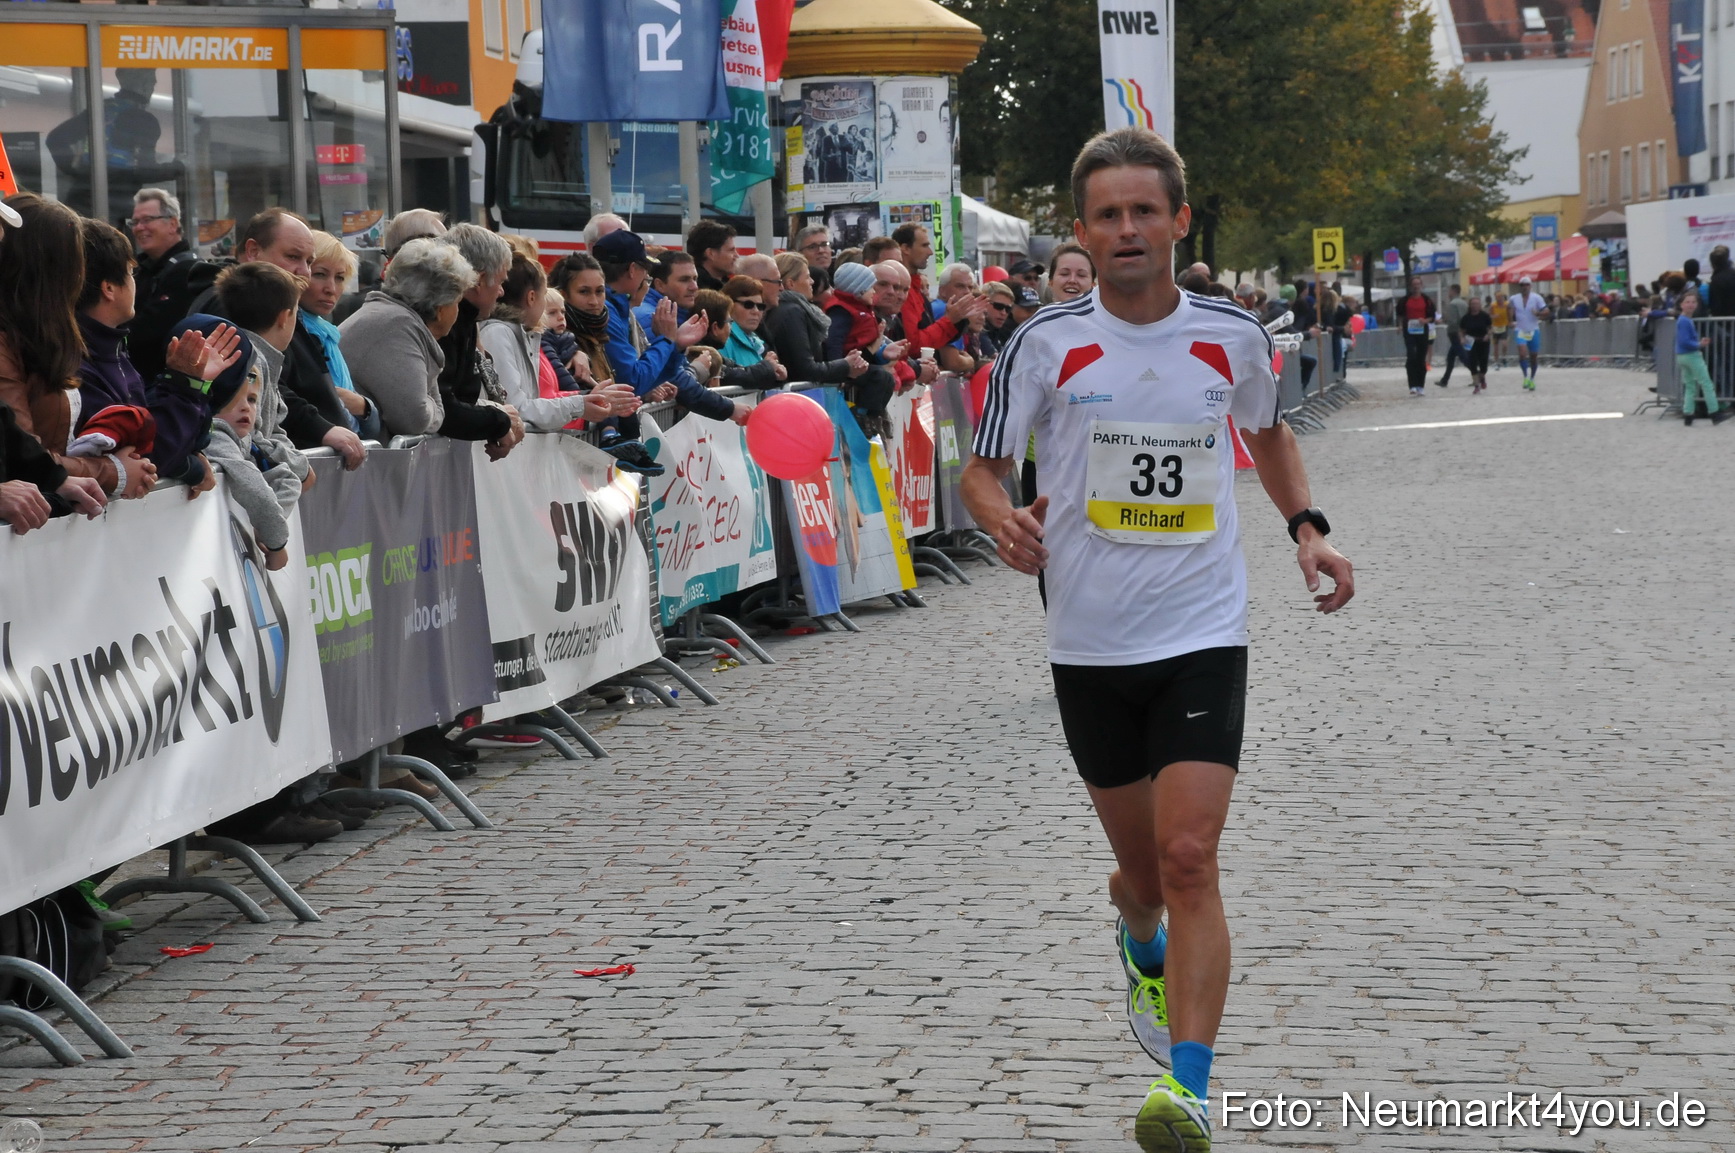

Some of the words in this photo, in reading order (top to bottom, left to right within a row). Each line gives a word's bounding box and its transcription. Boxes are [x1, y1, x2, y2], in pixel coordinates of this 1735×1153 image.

[118, 35, 273, 61] RUNMARKT.DE
[1317, 230, 1339, 238] Block
[1322, 242, 1336, 262] D
[1093, 433, 1137, 446] PARTL
[1141, 436, 1201, 448] Neumarkt
[1130, 453, 1183, 498] 33
[1120, 508, 1185, 528] Richard
